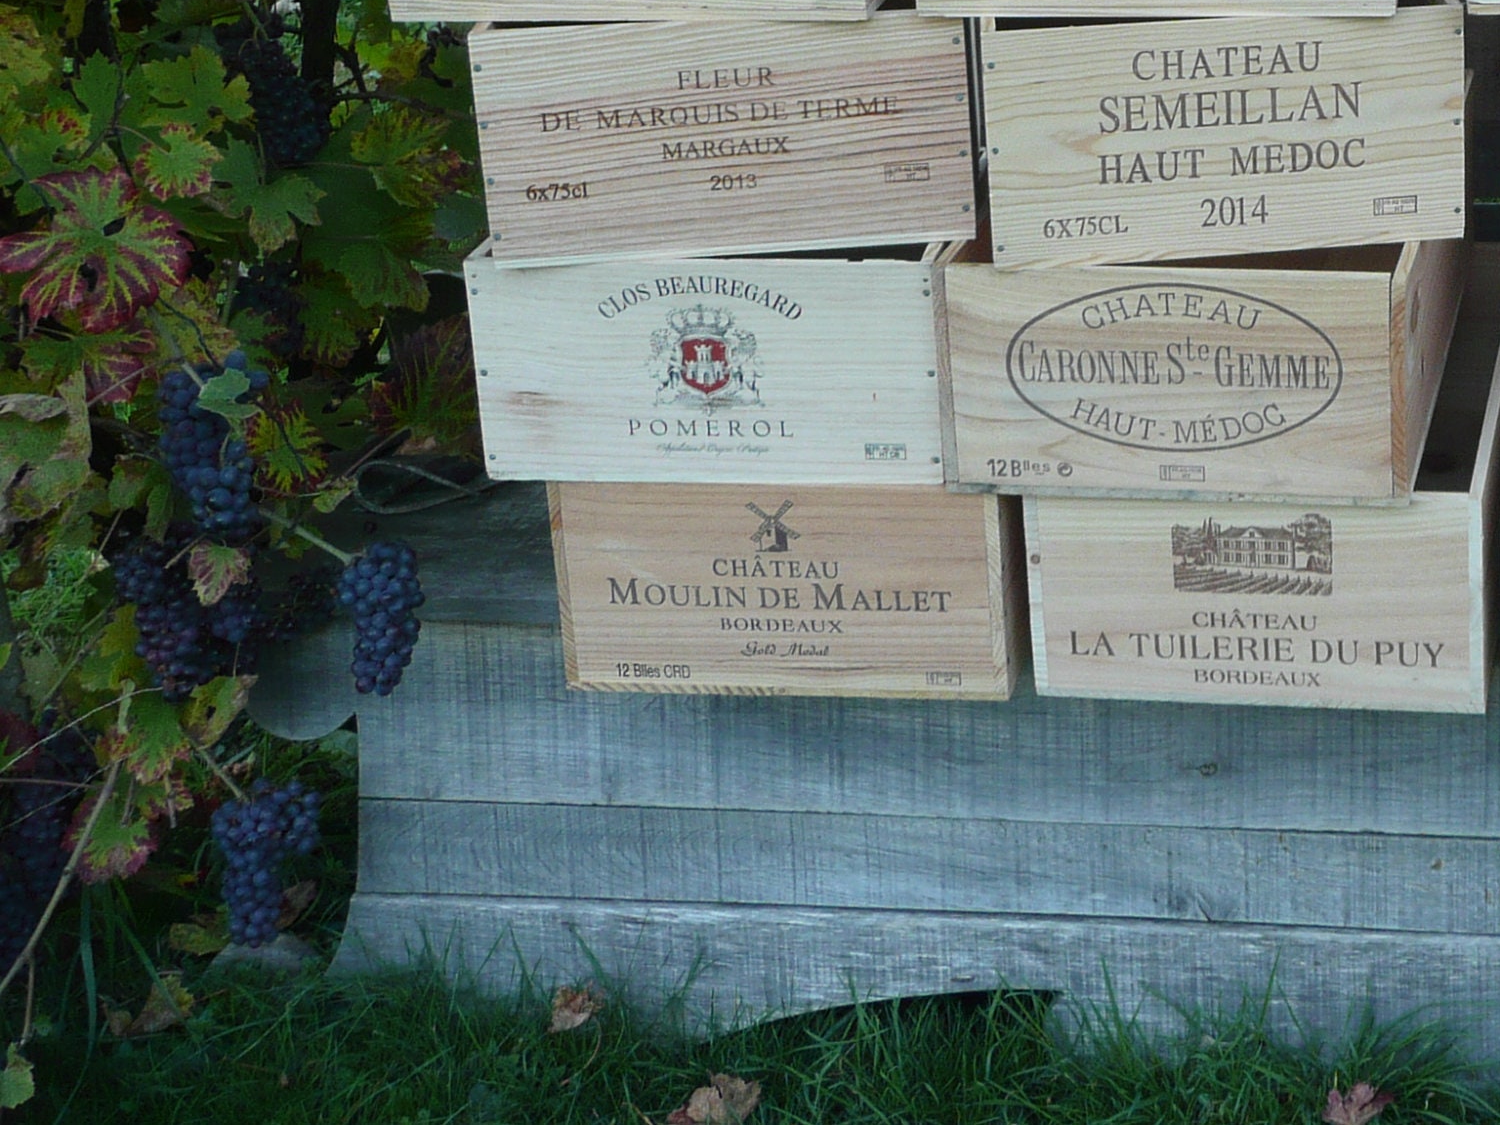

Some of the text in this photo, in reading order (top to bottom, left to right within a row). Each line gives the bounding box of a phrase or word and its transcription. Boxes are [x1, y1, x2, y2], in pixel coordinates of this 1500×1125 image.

[1132, 41, 1323, 81] CHATEAU
[677, 66, 775, 90] FLEUR
[540, 96, 899, 133] DE MARQUIS DE TERME
[1098, 80, 1362, 135] SEMEILLAN
[661, 136, 790, 160] MARGAUX
[1098, 138, 1366, 184] HAUT MEDOC
[526, 181, 589, 201] 6x75cl
[710, 174, 757, 192] 2013
[1201, 195, 1269, 227] 2014
[1043, 214, 1128, 239] 6X75CL
[597, 275, 804, 322] CLOS BEAUREGARD
[1081, 292, 1262, 331] CHATEAU
[1018, 340, 1160, 385] CARONNE
[629, 418, 794, 438] POMEROL
[1070, 398, 1288, 444] HAUT-MÉDOC
[986, 459, 1008, 476] 12
[712, 556, 840, 579] CHÂTEAU
[607, 578, 951, 613] MOULIN DE MALLET
[721, 617, 844, 634] BORDEAUX
[1192, 608, 1318, 632] CHÂTEAU
[740, 641, 777, 658] Gold
[1070, 630, 1445, 668] LA TUILERIE DU PUY
[616, 662, 631, 677] 12
[663, 664, 691, 679] CRD
[1194, 669, 1322, 687] BORDEAUX
